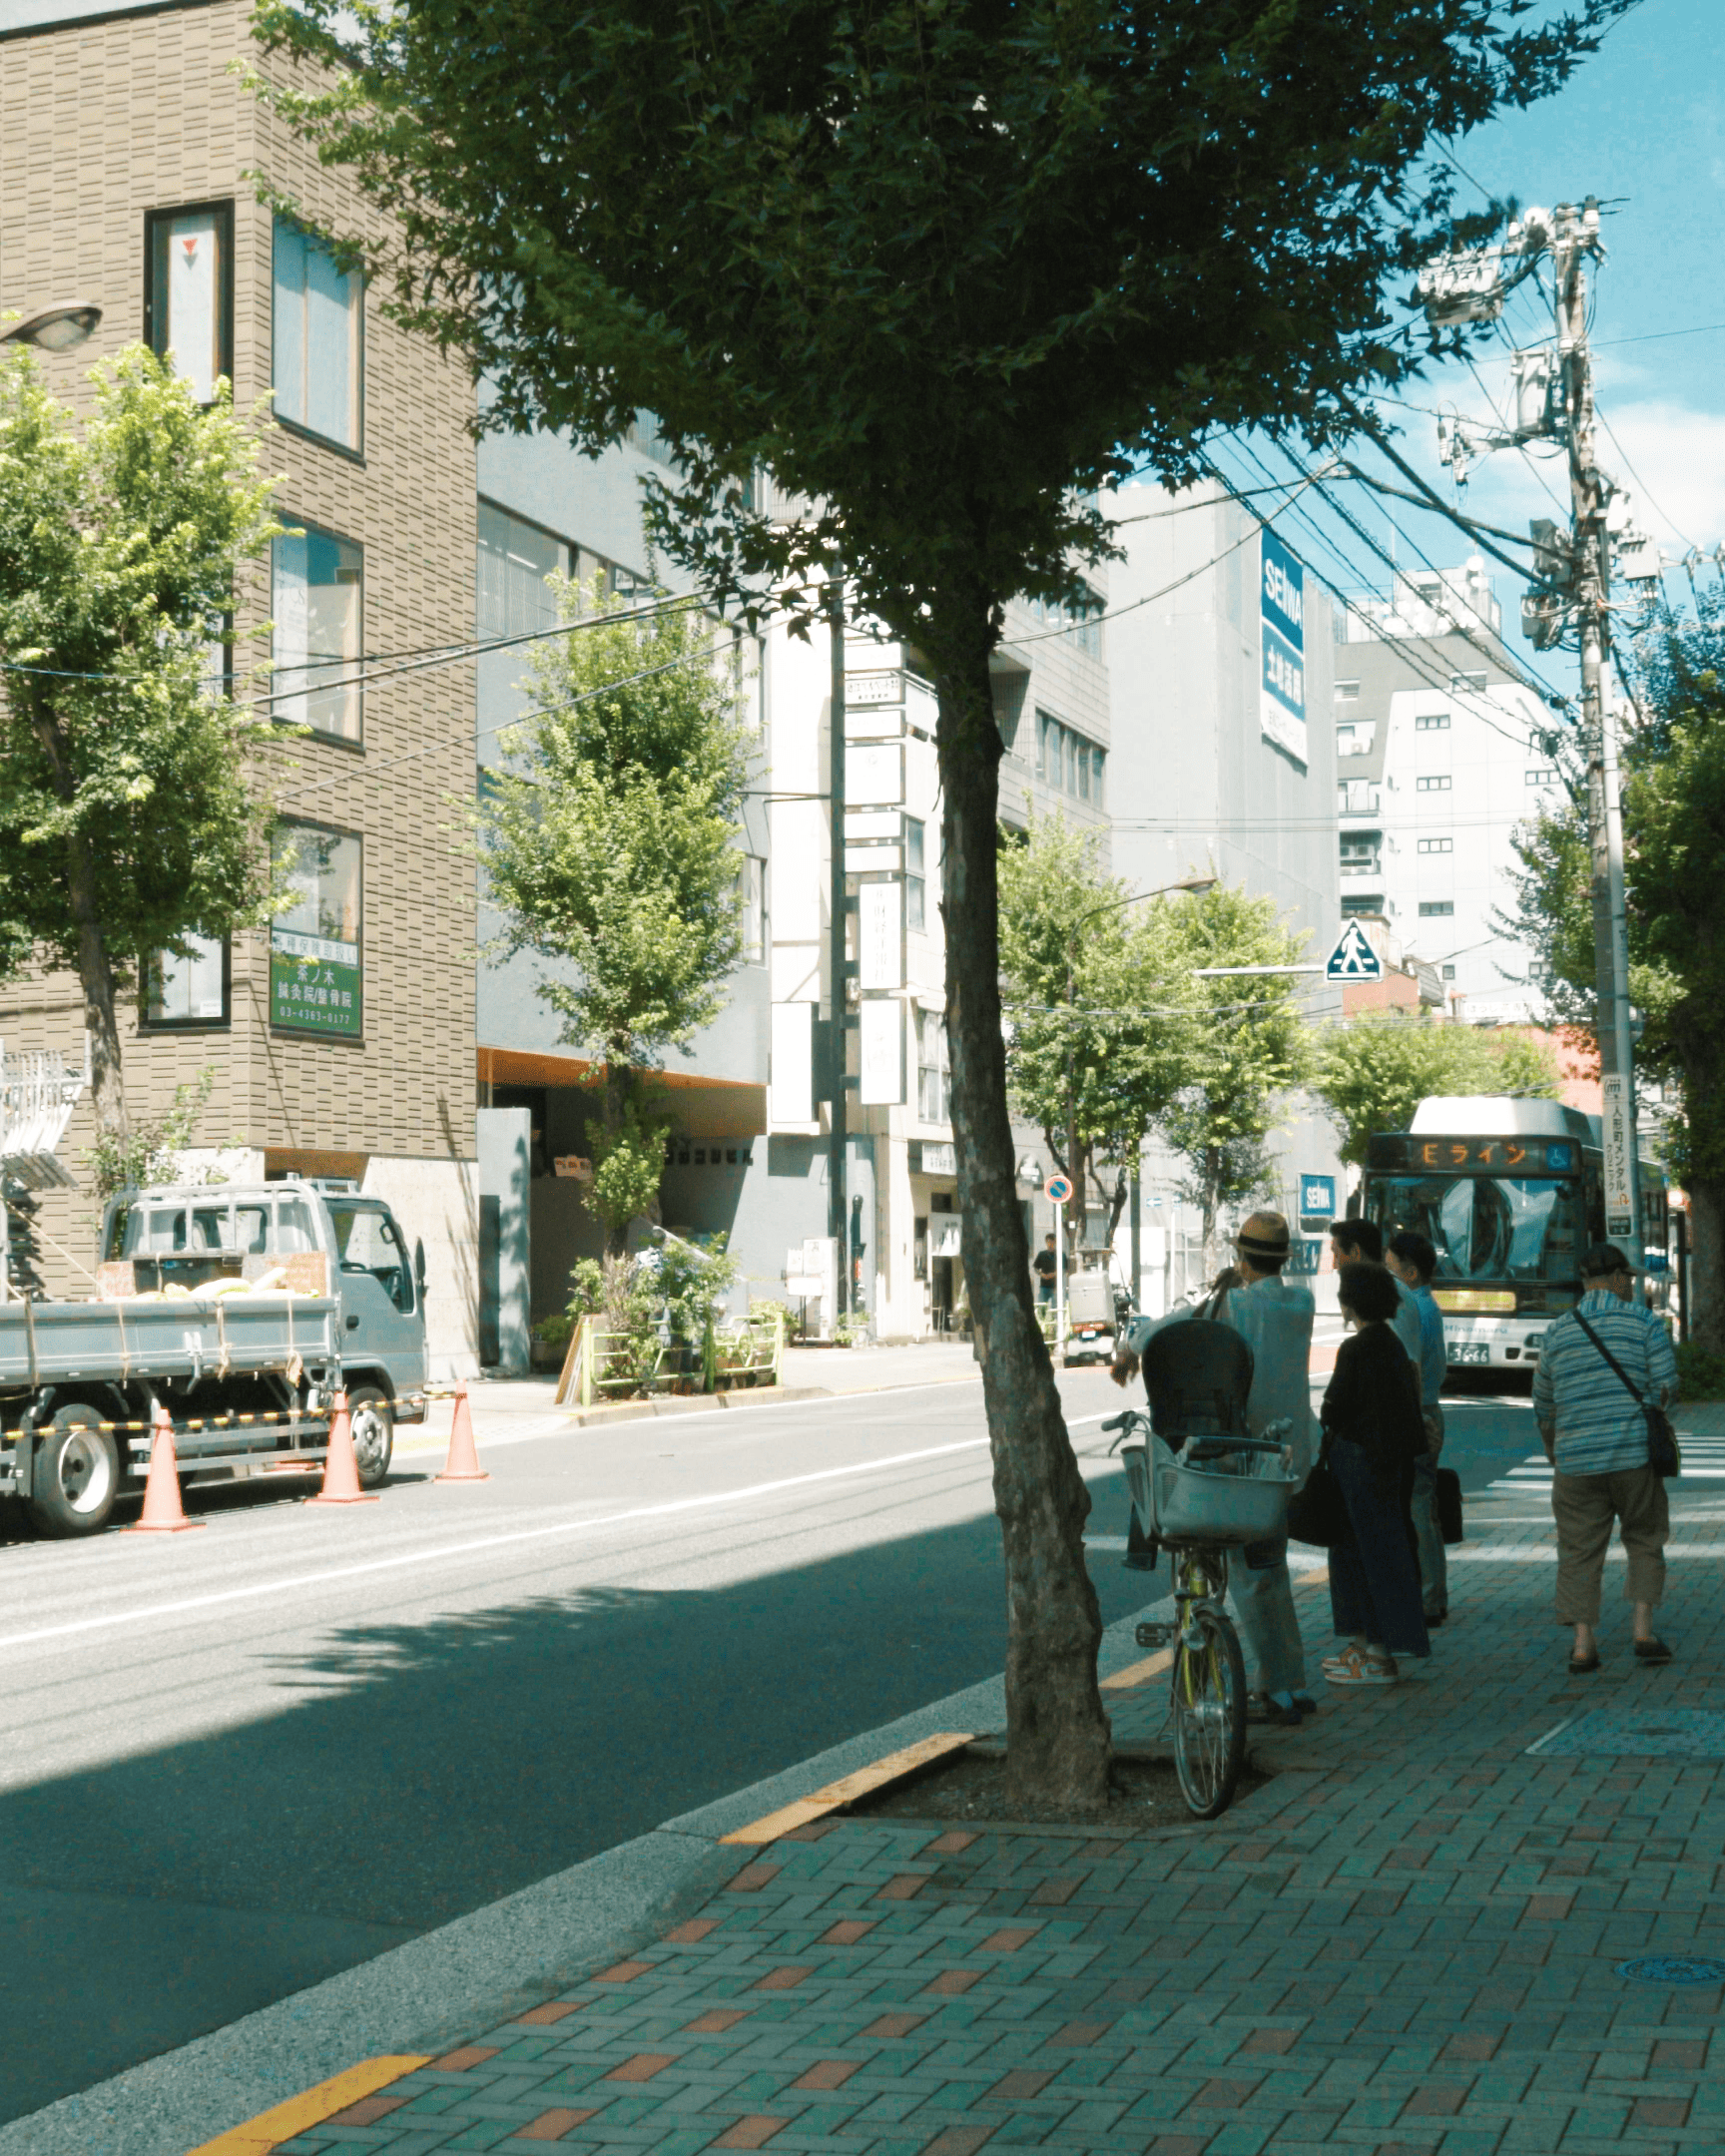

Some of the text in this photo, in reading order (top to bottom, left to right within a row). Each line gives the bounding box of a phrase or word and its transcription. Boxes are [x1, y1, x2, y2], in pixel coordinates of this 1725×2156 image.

[1265, 559, 1303, 631] SEIWA
[296, 964, 334, 986] 茶ノ木
[1423, 1144, 1526, 1165] Eライン
[1613, 1105, 1626, 1191] 人形町メンタル
[1307, 1182, 1330, 1209] SEIWA
